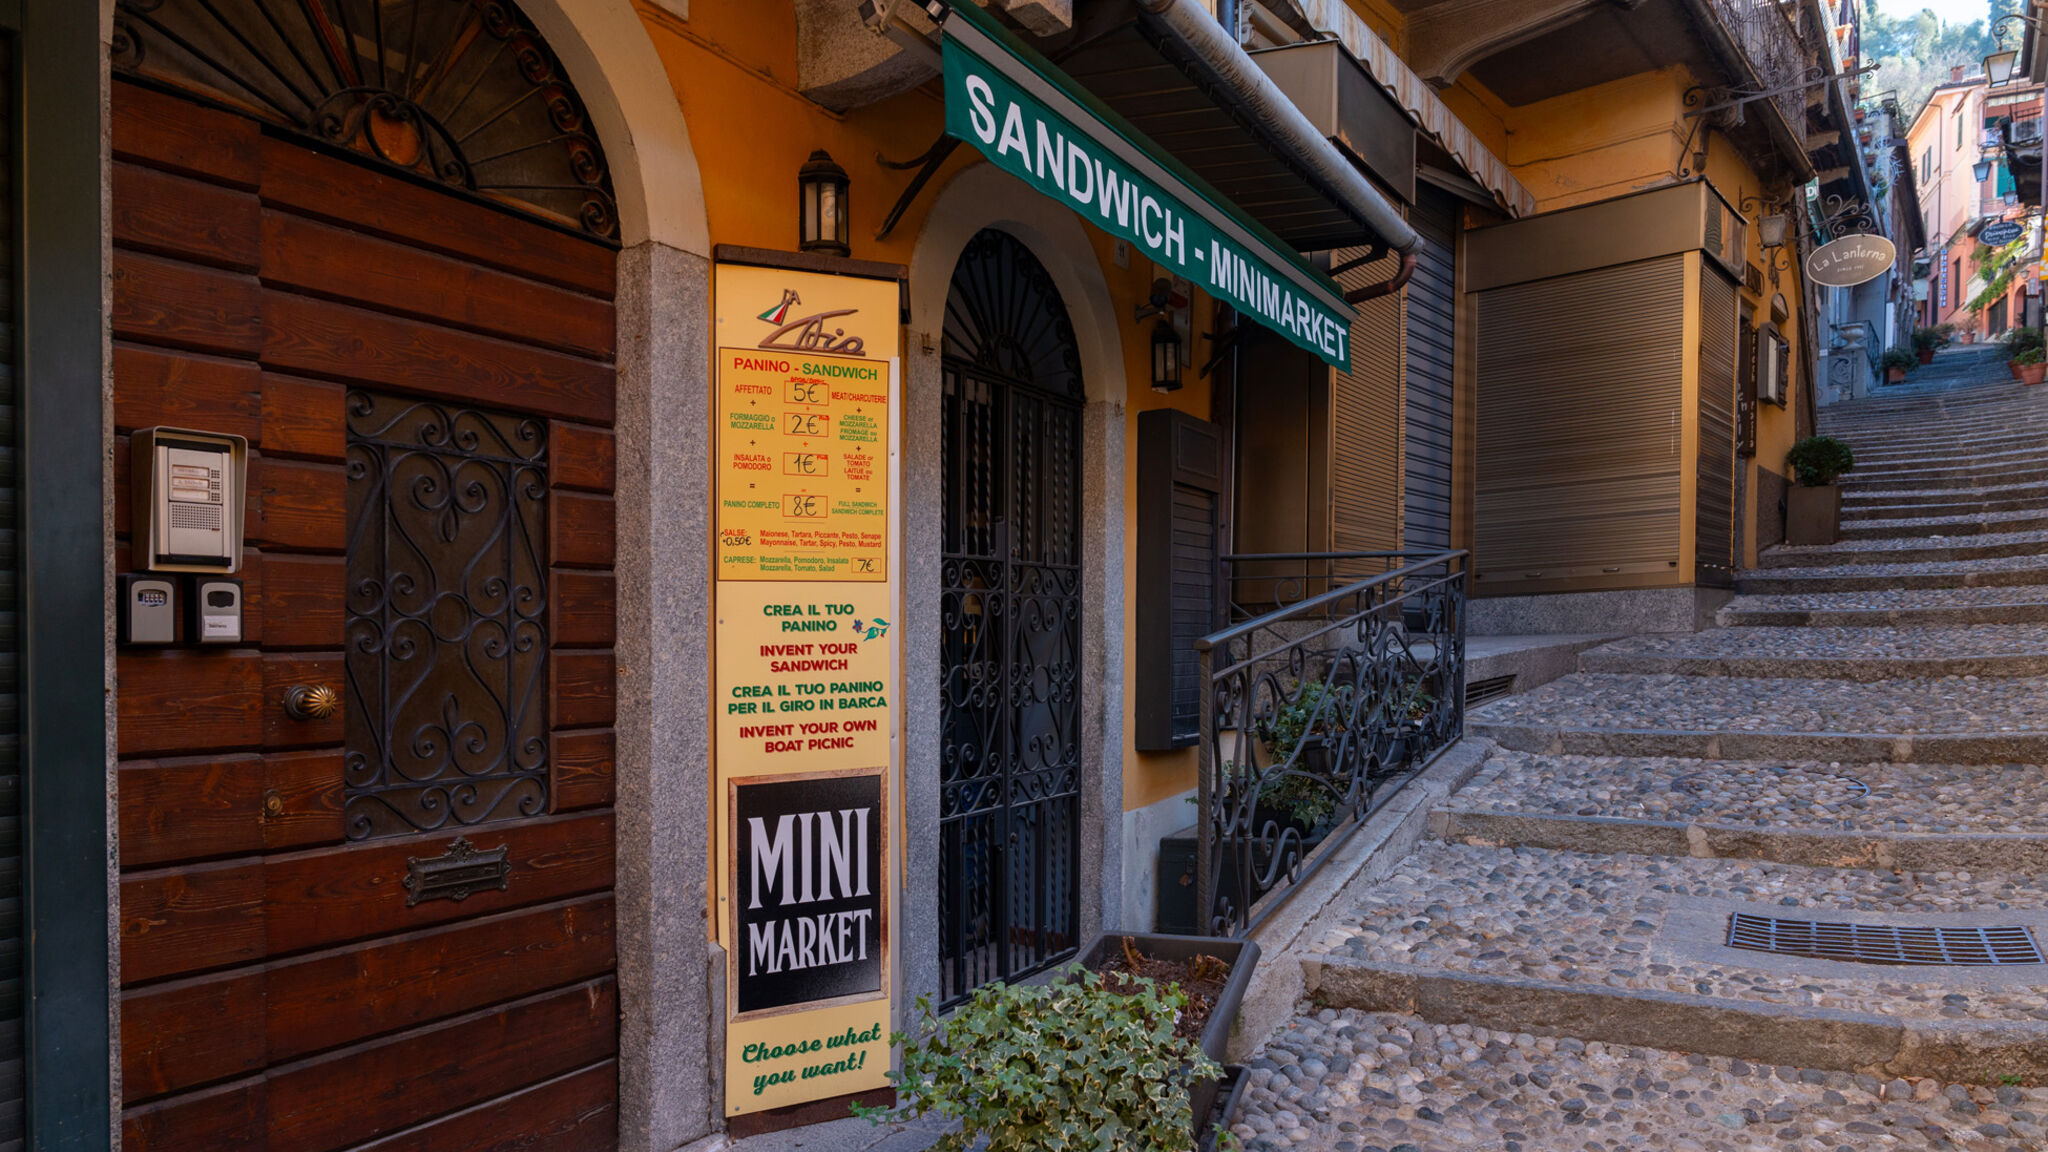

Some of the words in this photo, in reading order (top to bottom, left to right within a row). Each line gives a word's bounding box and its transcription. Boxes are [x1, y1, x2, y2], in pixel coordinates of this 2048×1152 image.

[965, 74, 1185, 266] SANDWICH
[1210, 238, 1347, 361] MINIMARKET
[1813, 258, 1830, 272] La
[1832, 245, 1886, 263] Lanterna
[734, 357, 790, 373] PANINO
[802, 363, 878, 380] SANDWICH
[735, 384, 772, 395] AFFETTATO
[794, 383, 819, 403] 5€
[730, 413, 770, 422] FORMAGGIO
[730, 421, 774, 430] MOZZARELLA
[792, 415, 819, 434] 2€
[840, 420, 878, 428] MOZZARELLA
[733, 462, 772, 471] POMODORO
[734, 454, 765, 462] INSALATA
[793, 454, 816, 474] 1€
[724, 500, 746, 508] PANINO
[747, 501, 780, 509] COMPLETO
[793, 496, 817, 516] 8€
[857, 559, 874, 572] 7€
[763, 605, 803, 616] CREA
[808, 605, 820, 616] IL
[825, 604, 855, 615] TUO
[781, 620, 837, 632] PANINO
[760, 644, 814, 657] INVENT
[819, 643, 858, 655] YOUR
[770, 659, 848, 673] SANDWICH
[732, 685, 773, 698] CREA
[778, 685, 791, 696] IL
[795, 683, 825, 695] TUO
[830, 681, 884, 694] PANINO
[728, 703, 757, 715] PER
[762, 702, 775, 713] IL
[780, 700, 815, 712] GIRO
[820, 699, 834, 710] IN
[838, 696, 887, 709] BARCA
[740, 724, 794, 738] INVENT
[799, 722, 838, 735] YOUR
[843, 720, 877, 732] OWN
[765, 740, 803, 753] BOAT
[808, 737, 854, 750] PICNIC
[747, 807, 871, 910] MINI
[748, 908, 872, 977] MARKET
[742, 1042, 822, 1063] Choose
[826, 1022, 881, 1049] what
[753, 1070, 796, 1096] you
[801, 1050, 867, 1080] want!
